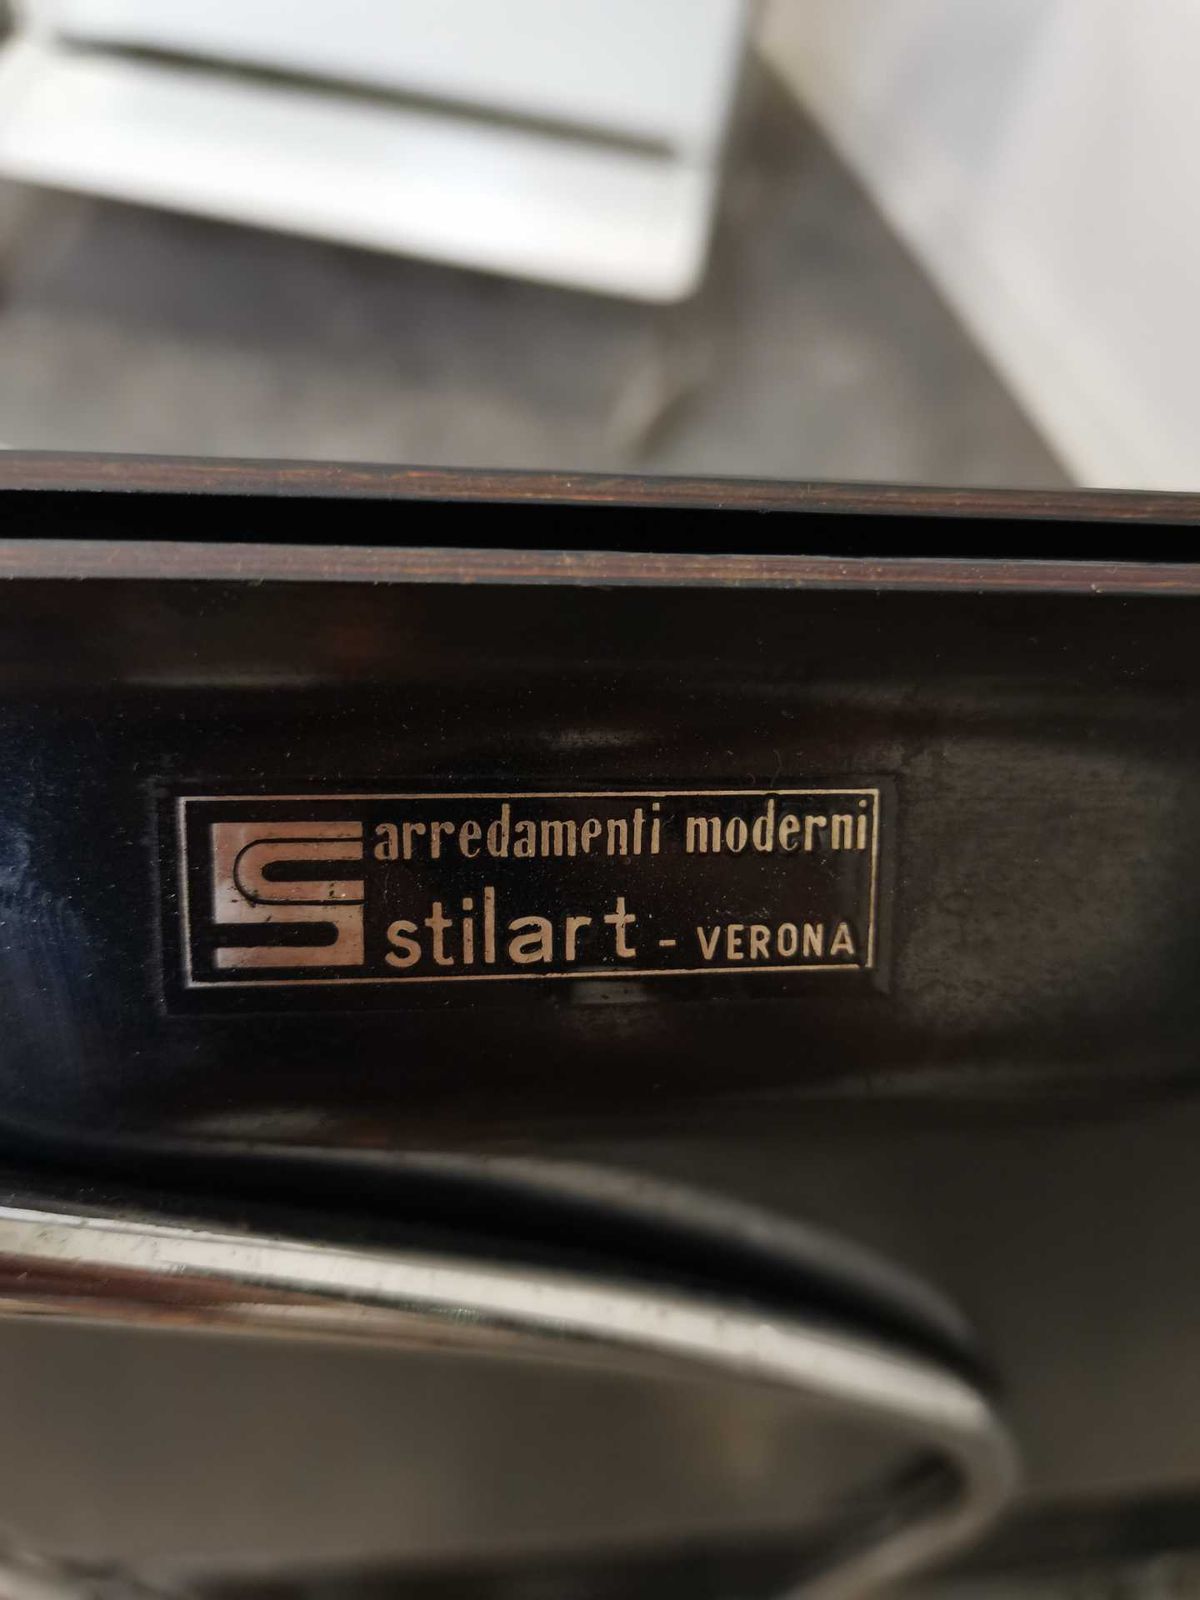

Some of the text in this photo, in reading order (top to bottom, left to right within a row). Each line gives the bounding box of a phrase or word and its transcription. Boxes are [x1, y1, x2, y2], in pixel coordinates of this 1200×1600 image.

[374, 798, 867, 861] arredamenti moderni
[384, 886, 637, 968] stilart
[696, 922, 855, 961] VERONA
